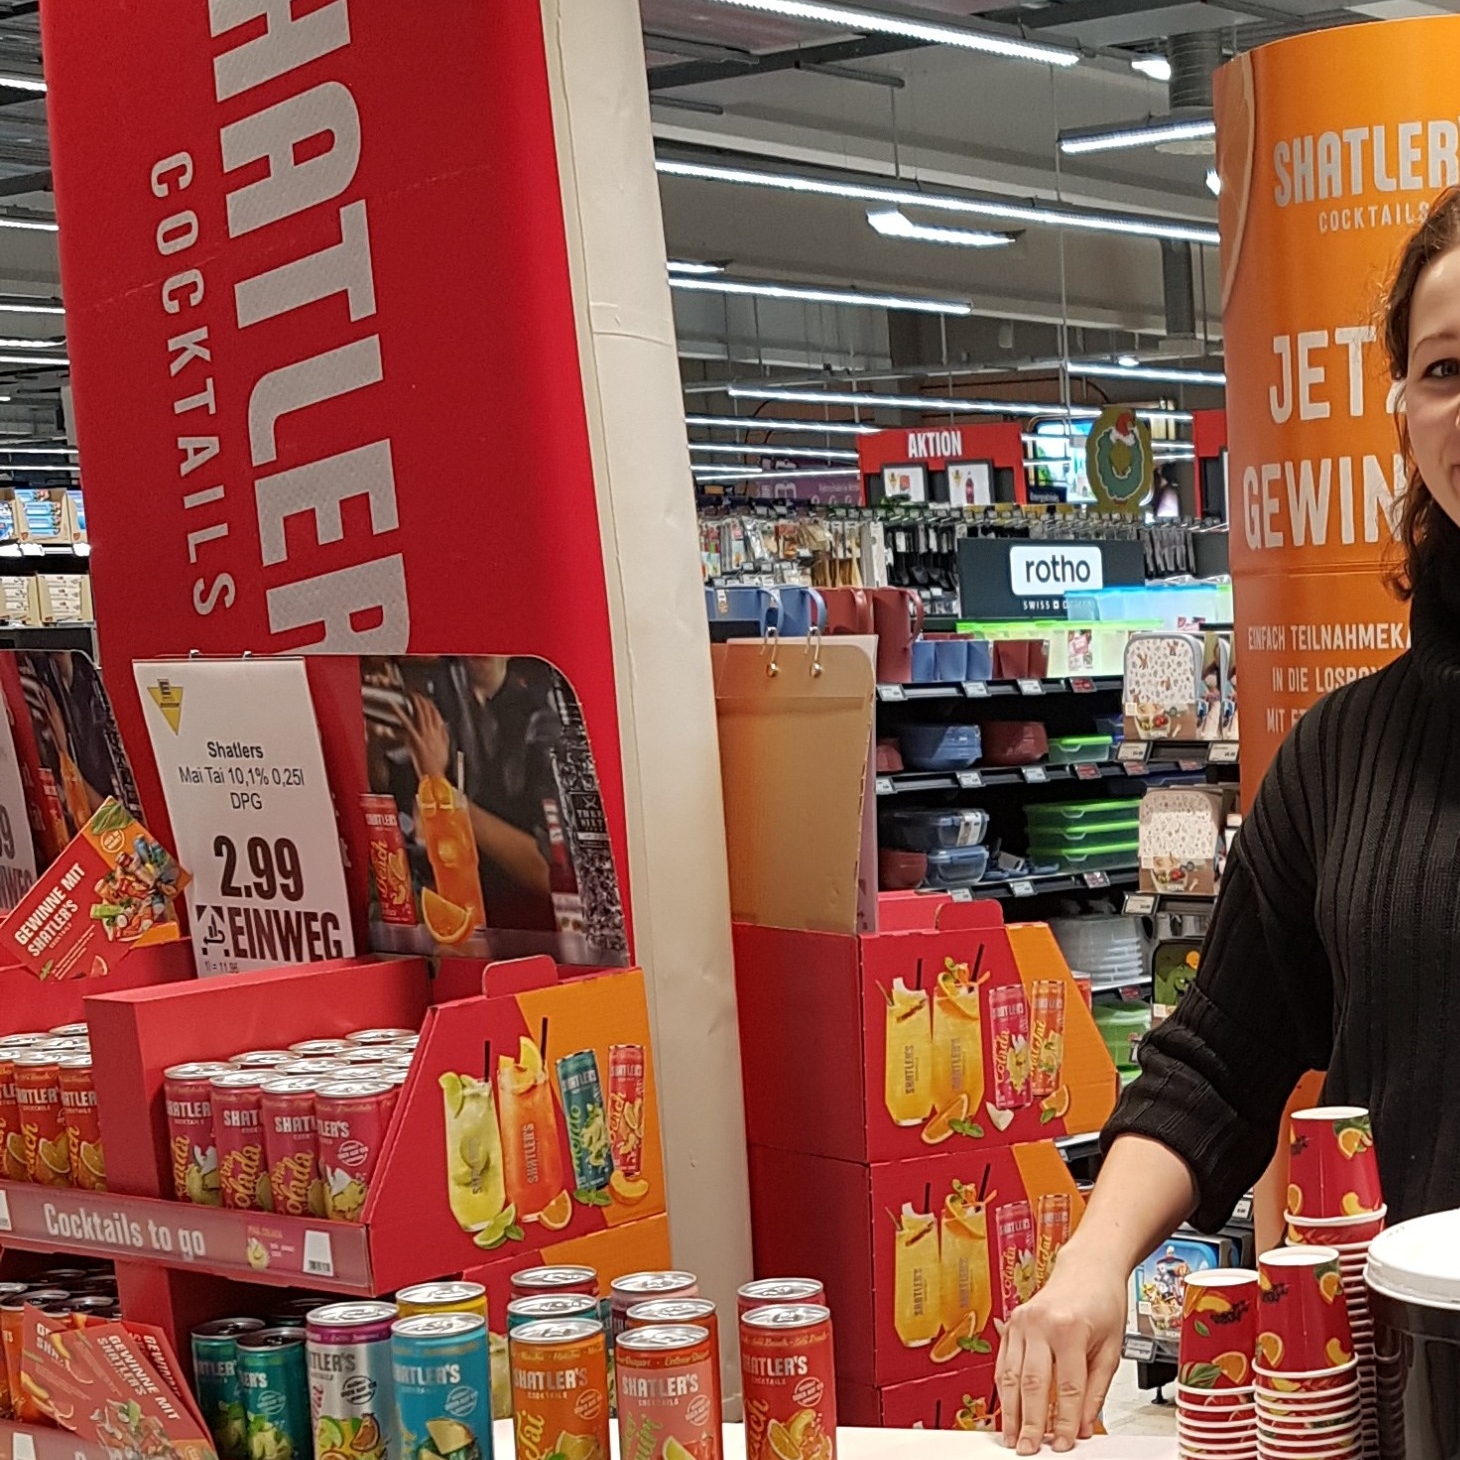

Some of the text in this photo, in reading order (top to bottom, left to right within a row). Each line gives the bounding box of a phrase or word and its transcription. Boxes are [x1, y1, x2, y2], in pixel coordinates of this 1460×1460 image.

[1318, 201, 1429, 234] COCKTAILS
[151, 151, 236, 616] COCKTAILS
[908, 431, 962, 458] AKTION
[1025, 555, 1091, 583] rotho
[1023, 601, 1051, 610] SWISS
[1248, 625, 1286, 650] EINFACH
[1272, 667, 1284, 692] IN
[1288, 667, 1309, 692] DIE
[1267, 708, 1285, 733] MIT
[207, 742, 264, 759] Shatlers
[179, 766, 203, 784] Mai
[207, 766, 225, 784] Tai
[228, 768, 269, 786] 10,1%
[230, 793, 263, 810] DPG
[213, 835, 304, 901] 2.99
[15, 886, 67, 945] GEWINNE
[61, 863, 85, 890] MIT
[28, 899, 78, 957] SHATLER'S
[229, 906, 343, 962] EINWEG
[44, 1203, 206, 1261] Cocktails to go
[97, 1337, 147, 1396] SHATLER'S
[109, 1334, 180, 1421] GEWINNE MIT
[514, 1369, 589, 1390] SHATLER'S
[622, 1373, 699, 1395] SHATLER'S
